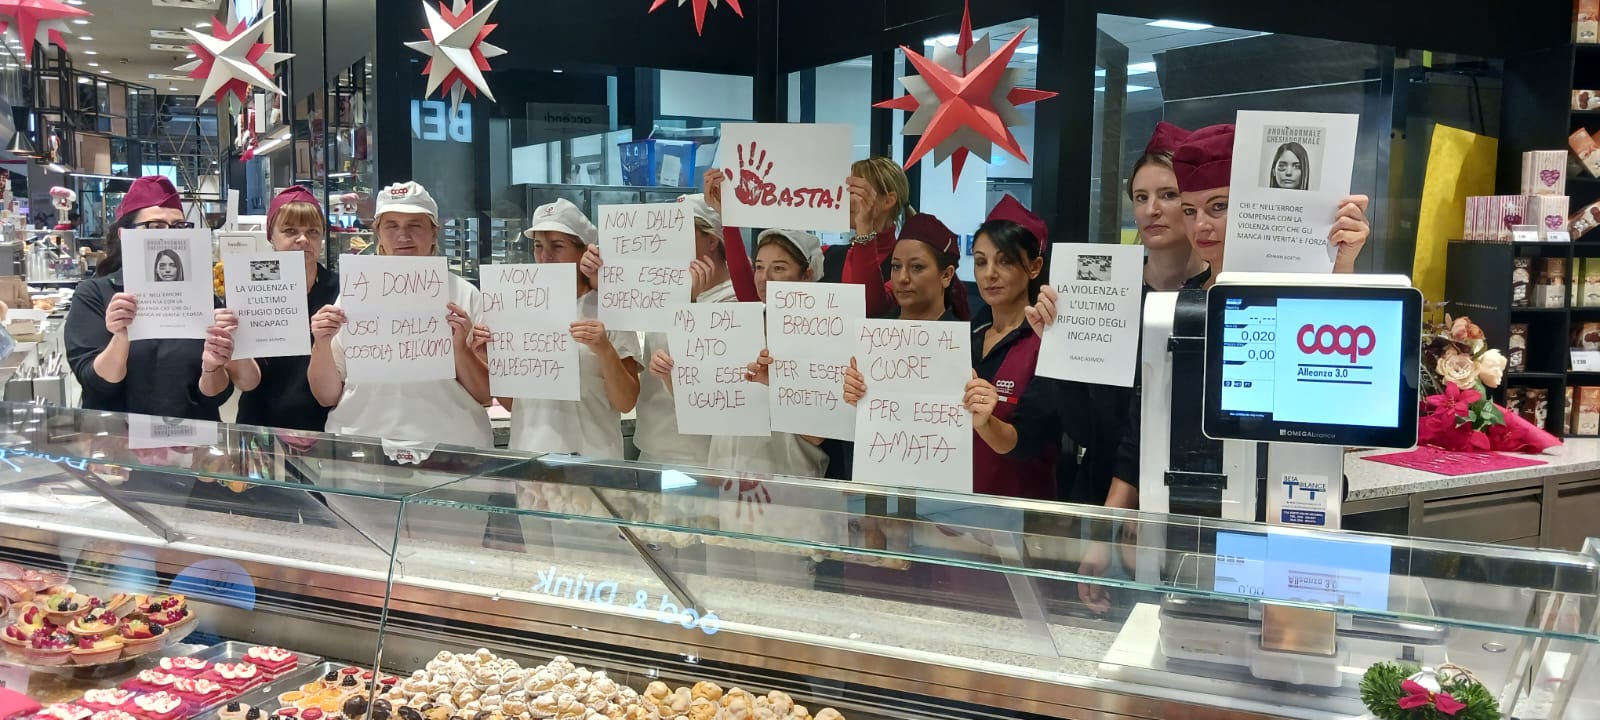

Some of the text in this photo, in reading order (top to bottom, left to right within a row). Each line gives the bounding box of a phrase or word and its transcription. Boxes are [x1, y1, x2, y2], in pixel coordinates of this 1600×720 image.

[761, 182, 842, 210] BASTA!
[605, 208, 686, 231] NON DALLA
[1238, 212, 1276, 221] COMPENSA
[1277, 214, 1293, 222] CON
[1238, 222, 1270, 231] VIOLENZA
[612, 233, 667, 254] TESTA
[1236, 233, 1262, 241] MANCA
[343, 269, 444, 302] LA DONNA
[500, 267, 539, 284] NON
[603, 265, 687, 286] PER ESSERE
[236, 284, 247, 293] LA
[247, 283, 290, 293] VIOLENZA
[601, 288, 672, 309] SUPERIORE
[1057, 284, 1130, 297] LA VIOLENZA E'
[247, 295, 287, 305] L'ULTIMO
[482, 287, 549, 313] DAI PIEDI
[775, 290, 839, 309] SOTTO IL
[1070, 299, 1116, 312] L'ULTIMO
[238, 307, 298, 317] RIFUGIO DEGLI
[674, 309, 742, 333] MA DAL
[1057, 314, 1127, 329] RIFUGIO DEGLI
[250, 319, 289, 328] INCAPACI
[392, 315, 440, 336] DALLA
[783, 314, 844, 337] BRACCIO
[491, 331, 568, 353] PER ESSERE
[860, 324, 960, 355] ACCANTO AL
[1067, 331, 1112, 343] INCAPACI
[1241, 330, 1276, 342] 0,020
[1296, 323, 1376, 364] coop
[344, 343, 393, 363] COSTOLA
[686, 337, 727, 361] LATO
[1248, 349, 1275, 360] 0,00
[488, 357, 565, 381] CALPESTATA
[678, 366, 701, 386] PER
[775, 360, 800, 381] PER
[870, 355, 931, 382] CUORE
[1297, 367, 1349, 378] Alleanza 3.0
[688, 390, 745, 411] UGUALE
[778, 387, 839, 411] PROTETTA
[869, 399, 964, 427] PER ESSERE
[869, 431, 957, 465] AMATA
